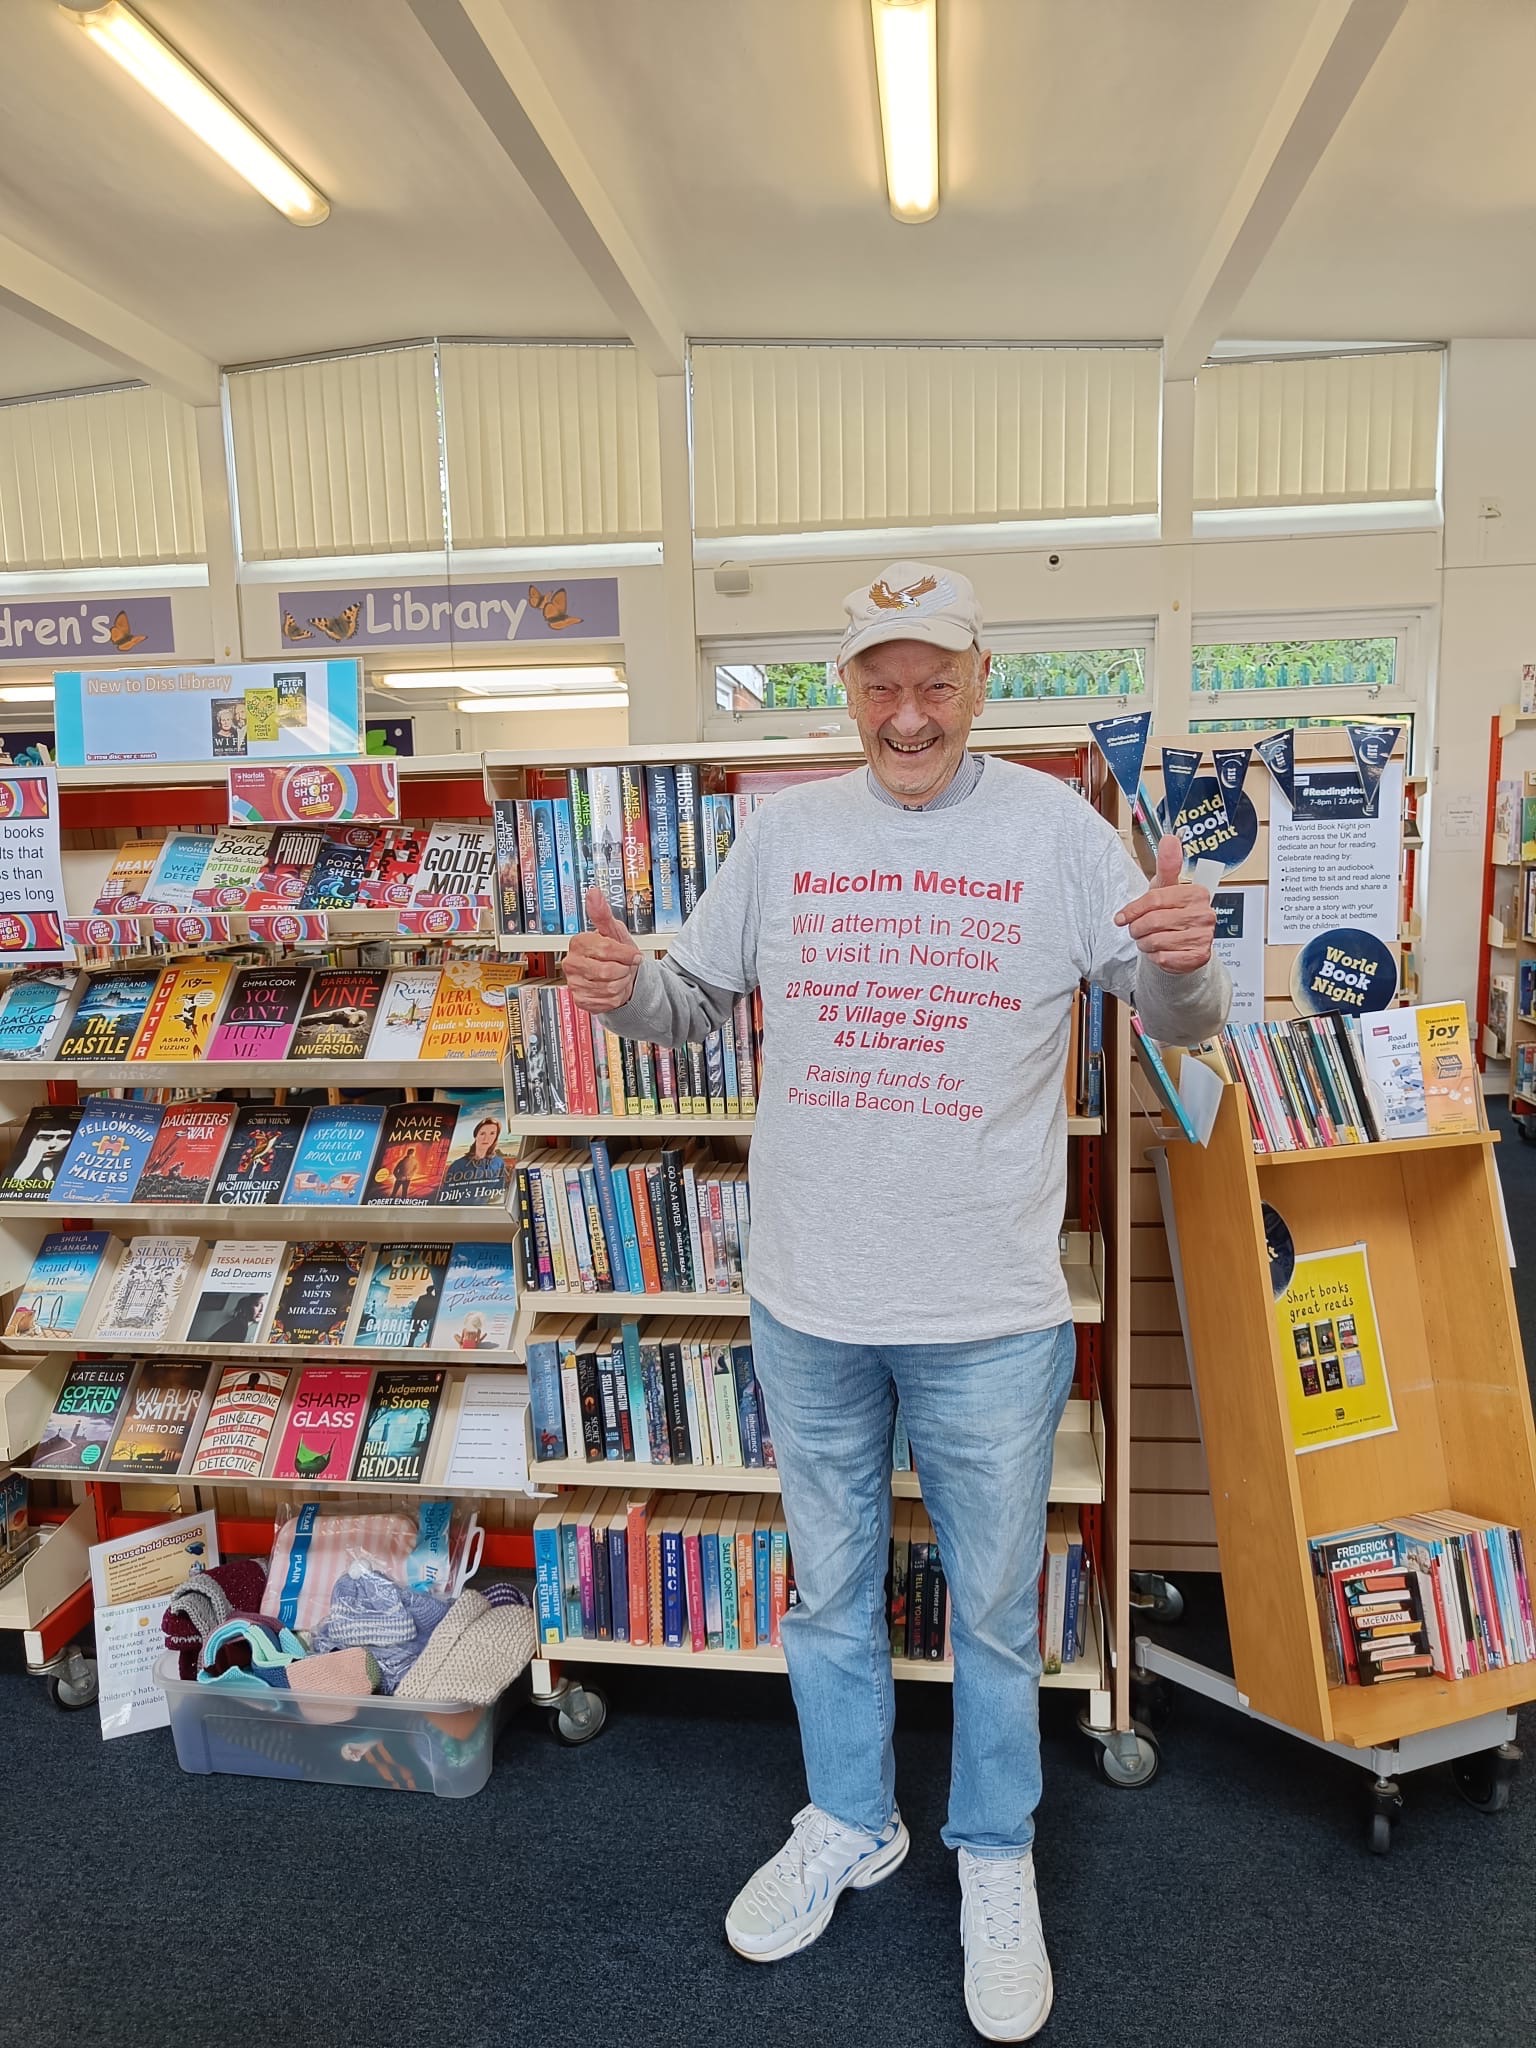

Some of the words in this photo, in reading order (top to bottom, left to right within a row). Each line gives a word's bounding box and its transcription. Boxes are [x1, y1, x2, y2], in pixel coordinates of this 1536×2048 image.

[366, 591, 527, 640] Library
[88, 678, 120, 694] New
[127, 678, 140, 692] to
[146, 676, 174, 692] Diss
[179, 674, 232, 692] Library
[293, 775, 326, 788] GREAT
[654, 774, 667, 804] JAMES
[302, 794, 329, 806] READ
[676, 772, 693, 813] HOUSE
[571, 777, 583, 840] PATTERSON
[580, 791, 591, 825] JAMES
[621, 772, 633, 832] PATTERSON
[630, 784, 640, 819] JAMES
[4, 826, 44, 838] books
[503, 821, 514, 852] JAMES
[657, 806, 669, 855] PATTERSON
[458, 833, 485, 849] THE
[536, 822, 546, 868] PATTERSON
[679, 821, 696, 869] WOLVES
[1182, 825, 1239, 858] Night
[19, 846, 43, 859] that
[624, 836, 638, 879] ROME
[13, 867, 42, 880] than
[660, 857, 670, 884] CROSS
[1285, 866, 1316, 874] Listening
[524, 872, 536, 914] Russian
[609, 867, 623, 908] BLOW
[793, 870, 902, 895] Malcolm
[914, 870, 1024, 903] Metcalf
[25, 888, 54, 902] long
[793, 913, 824, 935] Will
[831, 914, 921, 938] attempt
[930, 915, 950, 935] in
[960, 917, 1021, 945] 2025
[802, 945, 817, 963] to
[826, 943, 871, 963] visit
[879, 943, 899, 964] in
[909, 944, 999, 973] Norfolk
[1325, 946, 1378, 976] World
[242, 980, 268, 988] EMMA
[271, 979, 296, 987] COOK
[321, 977, 373, 986] BARBARA
[1318, 960, 1372, 991] Book
[94, 981, 147, 990] SUTHERLAND
[1311, 976, 1366, 1007] Night
[246, 989, 285, 1003] YOU
[312, 987, 380, 1008] VINE
[440, 989, 471, 1004] VERA
[786, 982, 800, 999] 22
[803, 981, 859, 998] Round
[866, 981, 923, 1001] Tower
[929, 985, 1022, 1011] Churches
[135, 974, 175, 1057] BUTTER
[507, 998, 522, 1038] INSOMNIA
[819, 1005, 838, 1021] 25
[845, 1006, 907, 1028] Village
[913, 1009, 969, 1031] Signs
[86, 1017, 121, 1035] THE
[464, 1018, 504, 1031] Snooping
[316, 1033, 354, 1044] FATAL
[440, 1031, 471, 1045] DEAD
[1388, 1033, 1407, 1042] Road
[1428, 1025, 1460, 1041] joy
[61, 1036, 130, 1056] CASTLE
[294, 1044, 363, 1055] INVERSION
[834, 1030, 855, 1047] 45
[860, 1032, 945, 1053] Libraries
[233, 1043, 261, 1057] ME
[806, 1065, 871, 1087] Raising
[877, 1069, 930, 1089] funds
[937, 1073, 964, 1091] for
[789, 1088, 849, 1107] Priscilla
[855, 1092, 914, 1113] Bacon
[922, 1097, 983, 1121] Lodge
[395, 1116, 443, 1128] NAME
[79, 1121, 154, 1143] FELLOWSHIP
[187, 1127, 214, 1140] WAR
[314, 1129, 365, 1141] SECOND
[388, 1130, 442, 1142] MAKER
[75, 1152, 132, 1170] PUZZLE
[335, 1151, 363, 1162] CLUB
[68, 1165, 128, 1183] MAKERS
[439, 1187, 471, 1202] Dilly's
[474, 1186, 505, 1198] Hope
[672, 1202, 682, 1227] RIVER
[46, 1244, 99, 1252] O'FLANAGAN
[136, 1248, 184, 1257] SILENCE
[37, 1259, 70, 1273] stand
[242, 1257, 276, 1265] HADLEY
[210, 1268, 231, 1278] Bad
[233, 1268, 272, 1278] Dreams
[303, 1274, 340, 1282] ISLAND
[389, 1267, 429, 1281] BOYD
[302, 1290, 332, 1298] MISTS
[1286, 1286, 1315, 1304] Short
[1319, 1282, 1349, 1300] books
[288, 1307, 337, 1315] MIRACLES
[1289, 1303, 1321, 1324] great
[1325, 1297, 1354, 1311] reads
[365, 1319, 428, 1332] GABRIEL'S
[375, 1331, 413, 1346] MOON
[71, 1372, 95, 1382] KATE
[98, 1372, 125, 1382] ELLIS
[63, 1386, 121, 1400] COFFIN
[136, 1388, 202, 1407] WILBUR
[387, 1384, 439, 1395] Judgement
[58, 1400, 115, 1414] ISLAND
[231, 1392, 278, 1408] CAROLINE
[297, 1393, 361, 1409] SHARP
[390, 1395, 430, 1409] Stone
[133, 1402, 191, 1421] SMITH
[218, 1412, 265, 1426] BINGLEY
[292, 1411, 355, 1428] GLASS
[135, 1424, 156, 1433] TIME
[169, 1425, 185, 1434] DIE
[212, 1435, 257, 1448] PRIVATE
[363, 1441, 390, 1456] RUTH
[198, 1457, 257, 1473] DETECTIVE
[357, 1456, 420, 1478] RENDELL
[109, 1538, 161, 1564] Household
[162, 1527, 203, 1547] Support
[1337, 1539, 1388, 1557] FREDERICK
[292, 1554, 302, 1583] PLAIN
[666, 1539, 678, 1591] HERC
[723, 1566, 734, 1601] ROONEY
[539, 1583, 550, 1620] FUTURE
[1362, 1612, 1403, 1626] McEWAN
